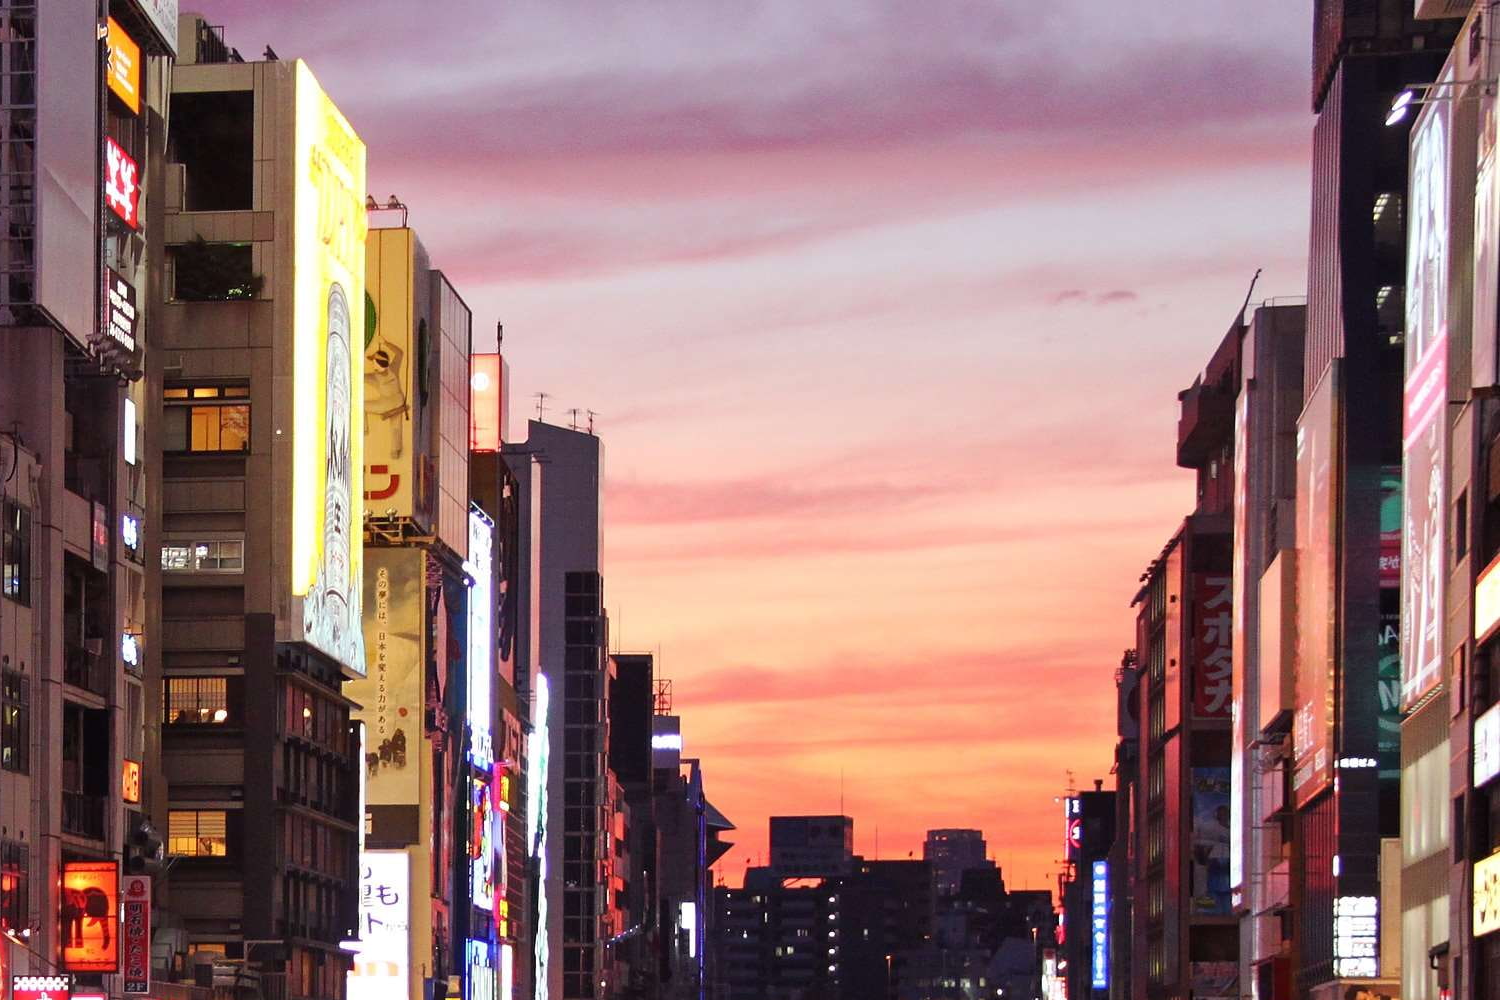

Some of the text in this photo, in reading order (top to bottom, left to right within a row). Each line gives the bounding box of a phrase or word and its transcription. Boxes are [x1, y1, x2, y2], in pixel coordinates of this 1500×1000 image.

[377, 632, 388, 735] 日本を変える力がある
[126, 982, 147, 993] 2F
